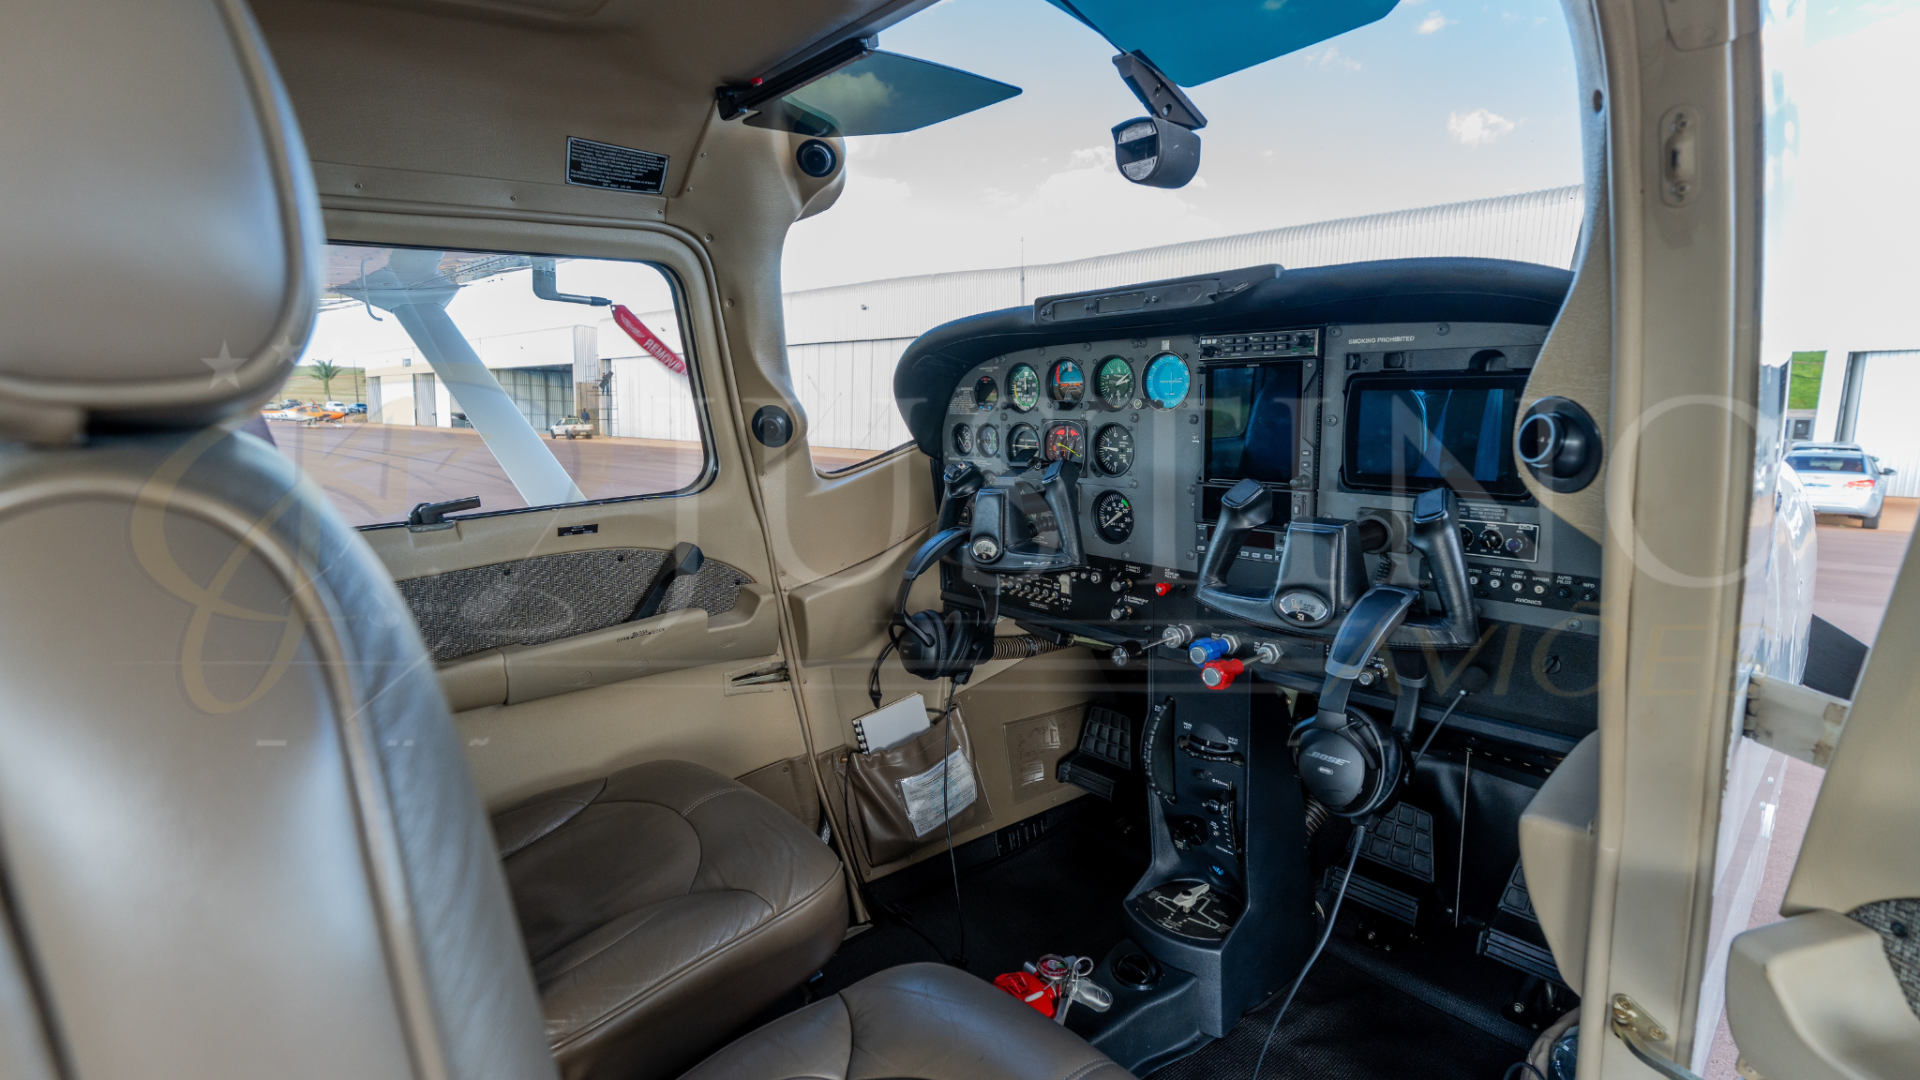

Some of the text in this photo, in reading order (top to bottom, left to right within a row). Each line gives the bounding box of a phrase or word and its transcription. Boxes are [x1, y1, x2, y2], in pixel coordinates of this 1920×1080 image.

[1348, 335, 1416, 345] SMOKING PROHIBITED
[1514, 597, 1542, 606] AVIONICS
[1306, 750, 1351, 766] BOSE
